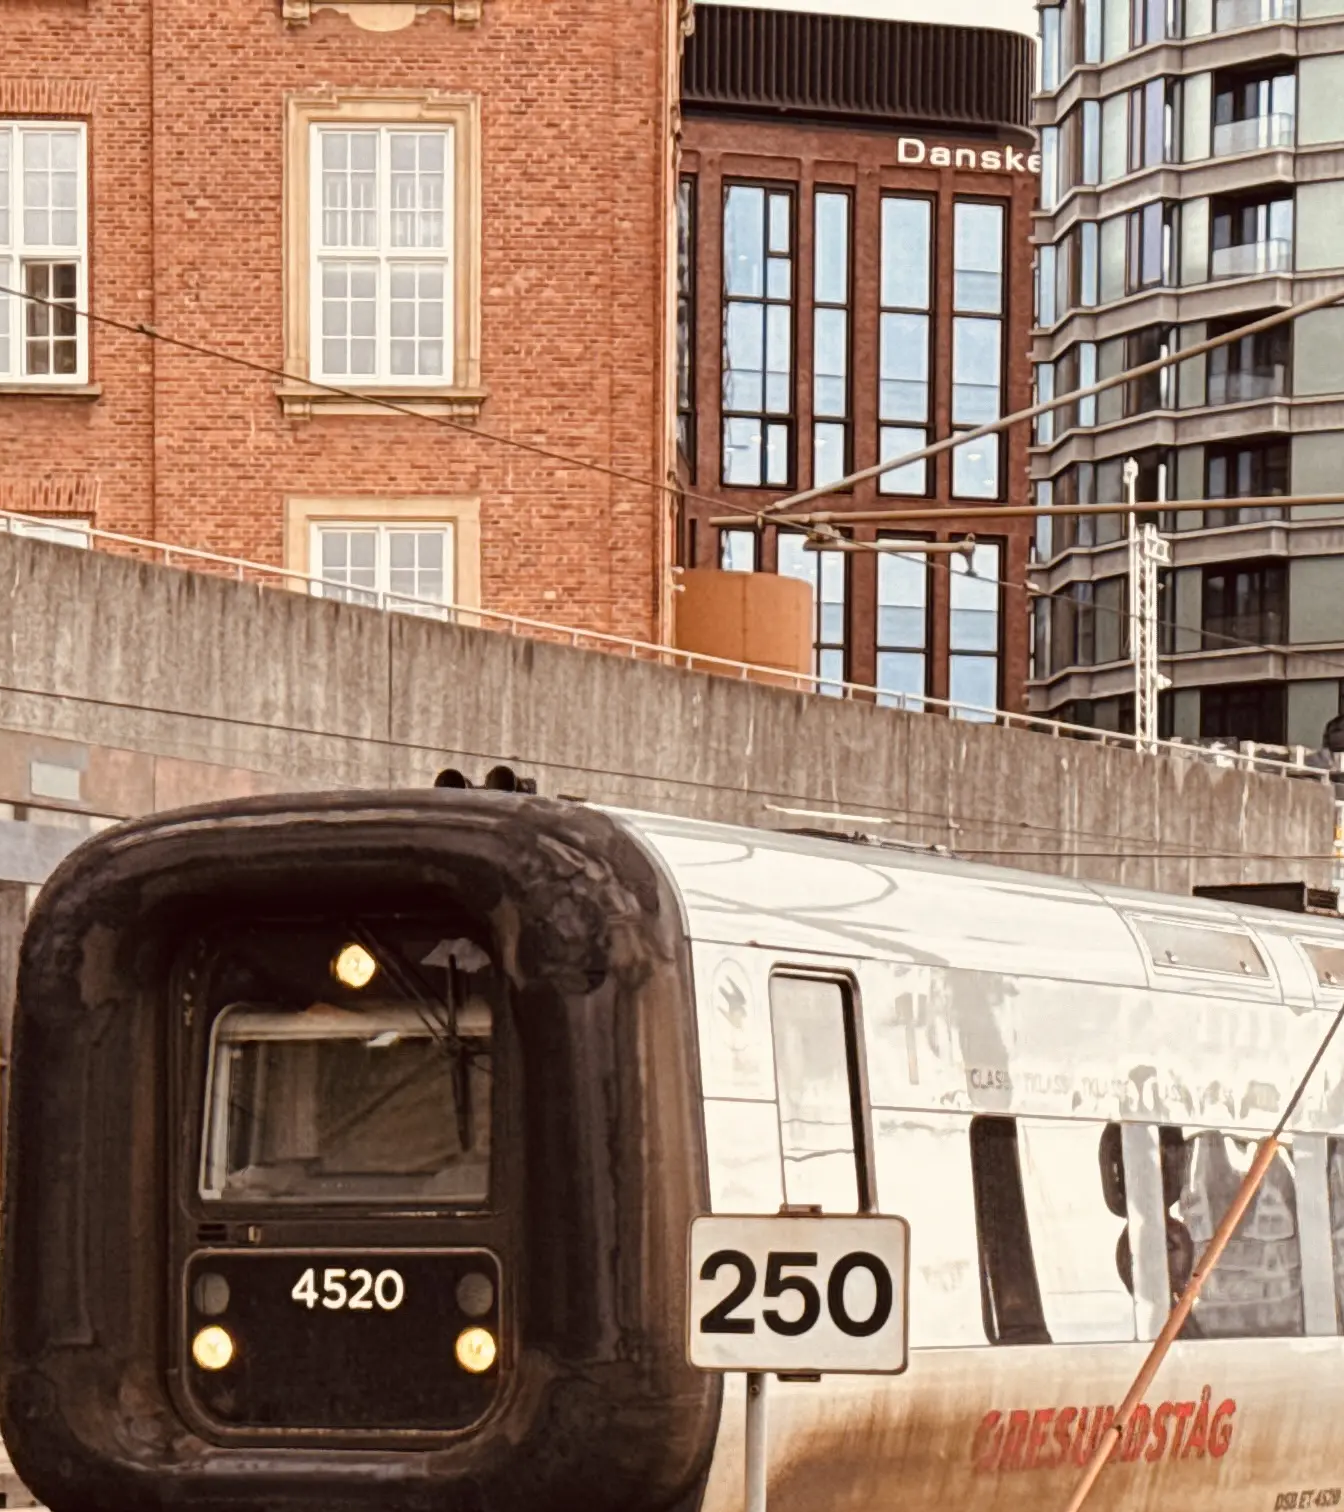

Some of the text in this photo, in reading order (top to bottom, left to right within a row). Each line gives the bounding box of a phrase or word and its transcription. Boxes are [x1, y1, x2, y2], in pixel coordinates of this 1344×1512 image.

[897, 137, 1042, 173] Danske
[291, 1267, 406, 1311] 4520
[698, 1249, 895, 1337] 250
[1299, 1489, 1315, 1509] ET
